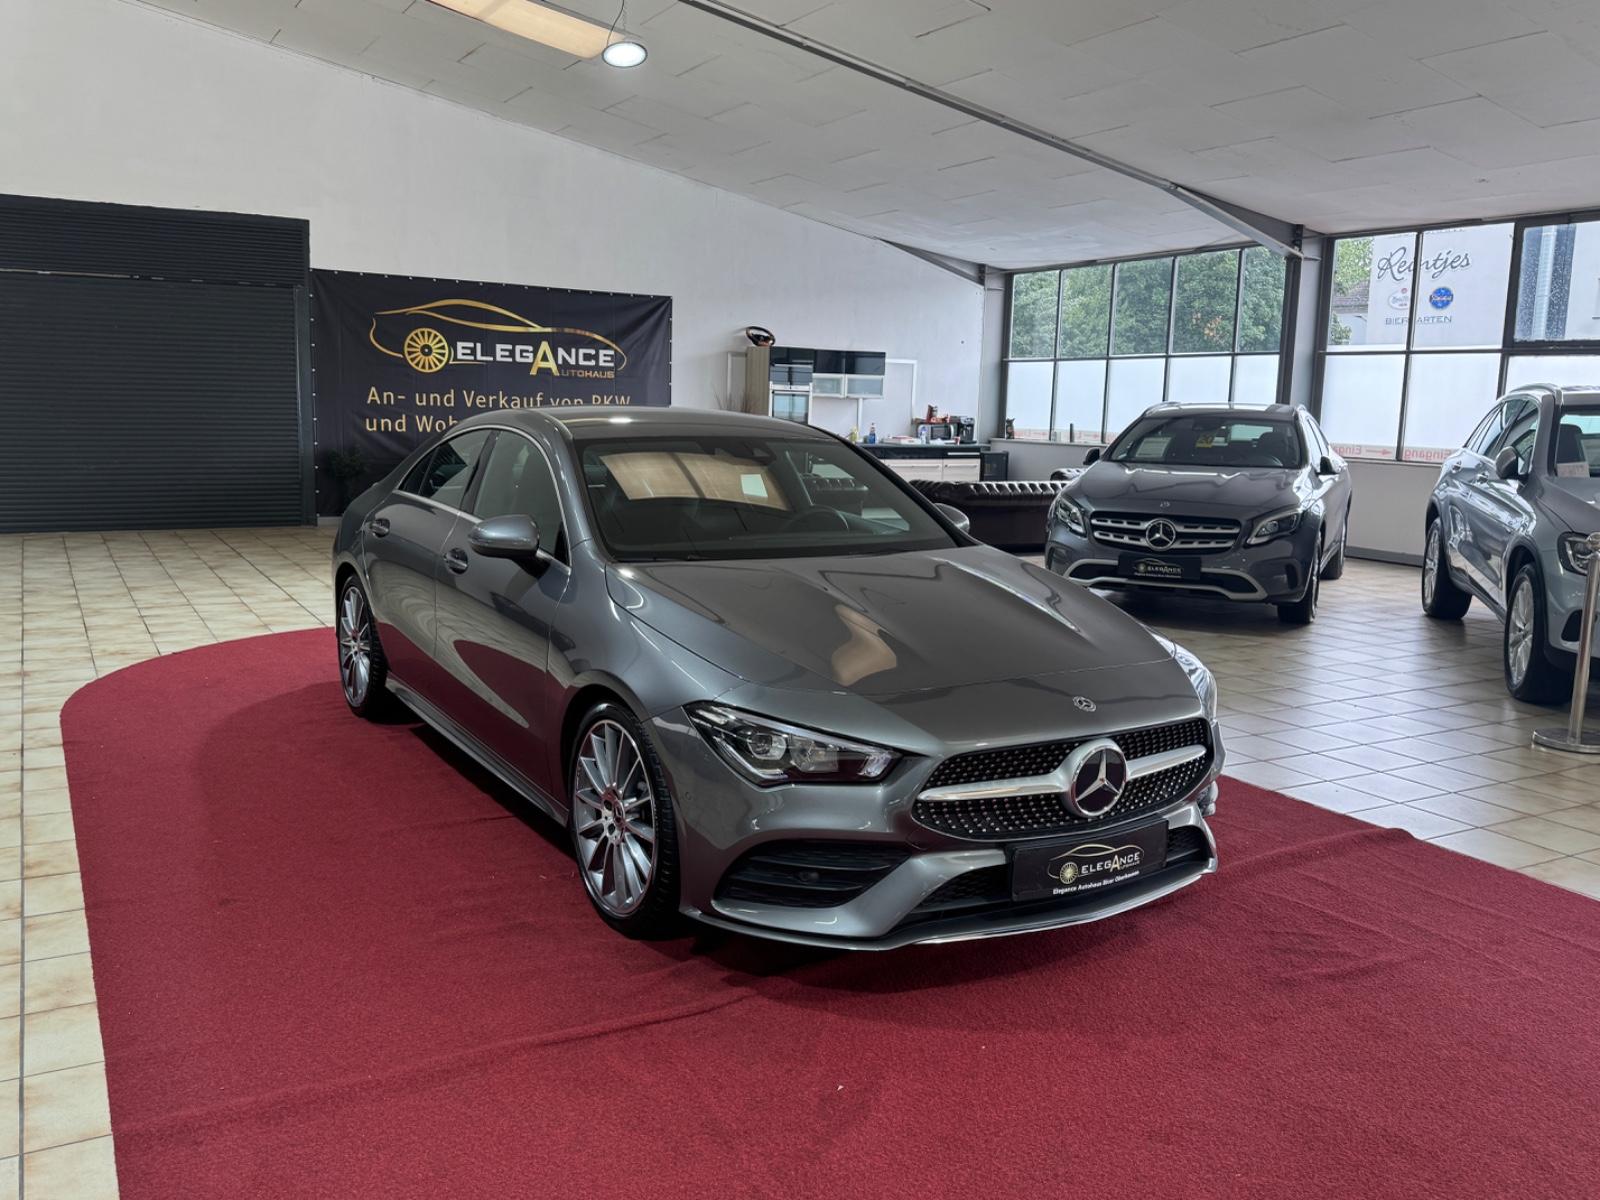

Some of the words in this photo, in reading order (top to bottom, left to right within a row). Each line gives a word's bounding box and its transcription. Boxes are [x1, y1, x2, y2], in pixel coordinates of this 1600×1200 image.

[1385, 315, 1452, 326] BIERARTEN
[456, 341, 615, 376] ELEGANCE
[367, 386, 406, 405] An-
[415, 389, 455, 406] und
[463, 390, 544, 409] Verkauf
[365, 414, 406, 432] und
[1081, 852, 1140, 873] ELEGANCE
